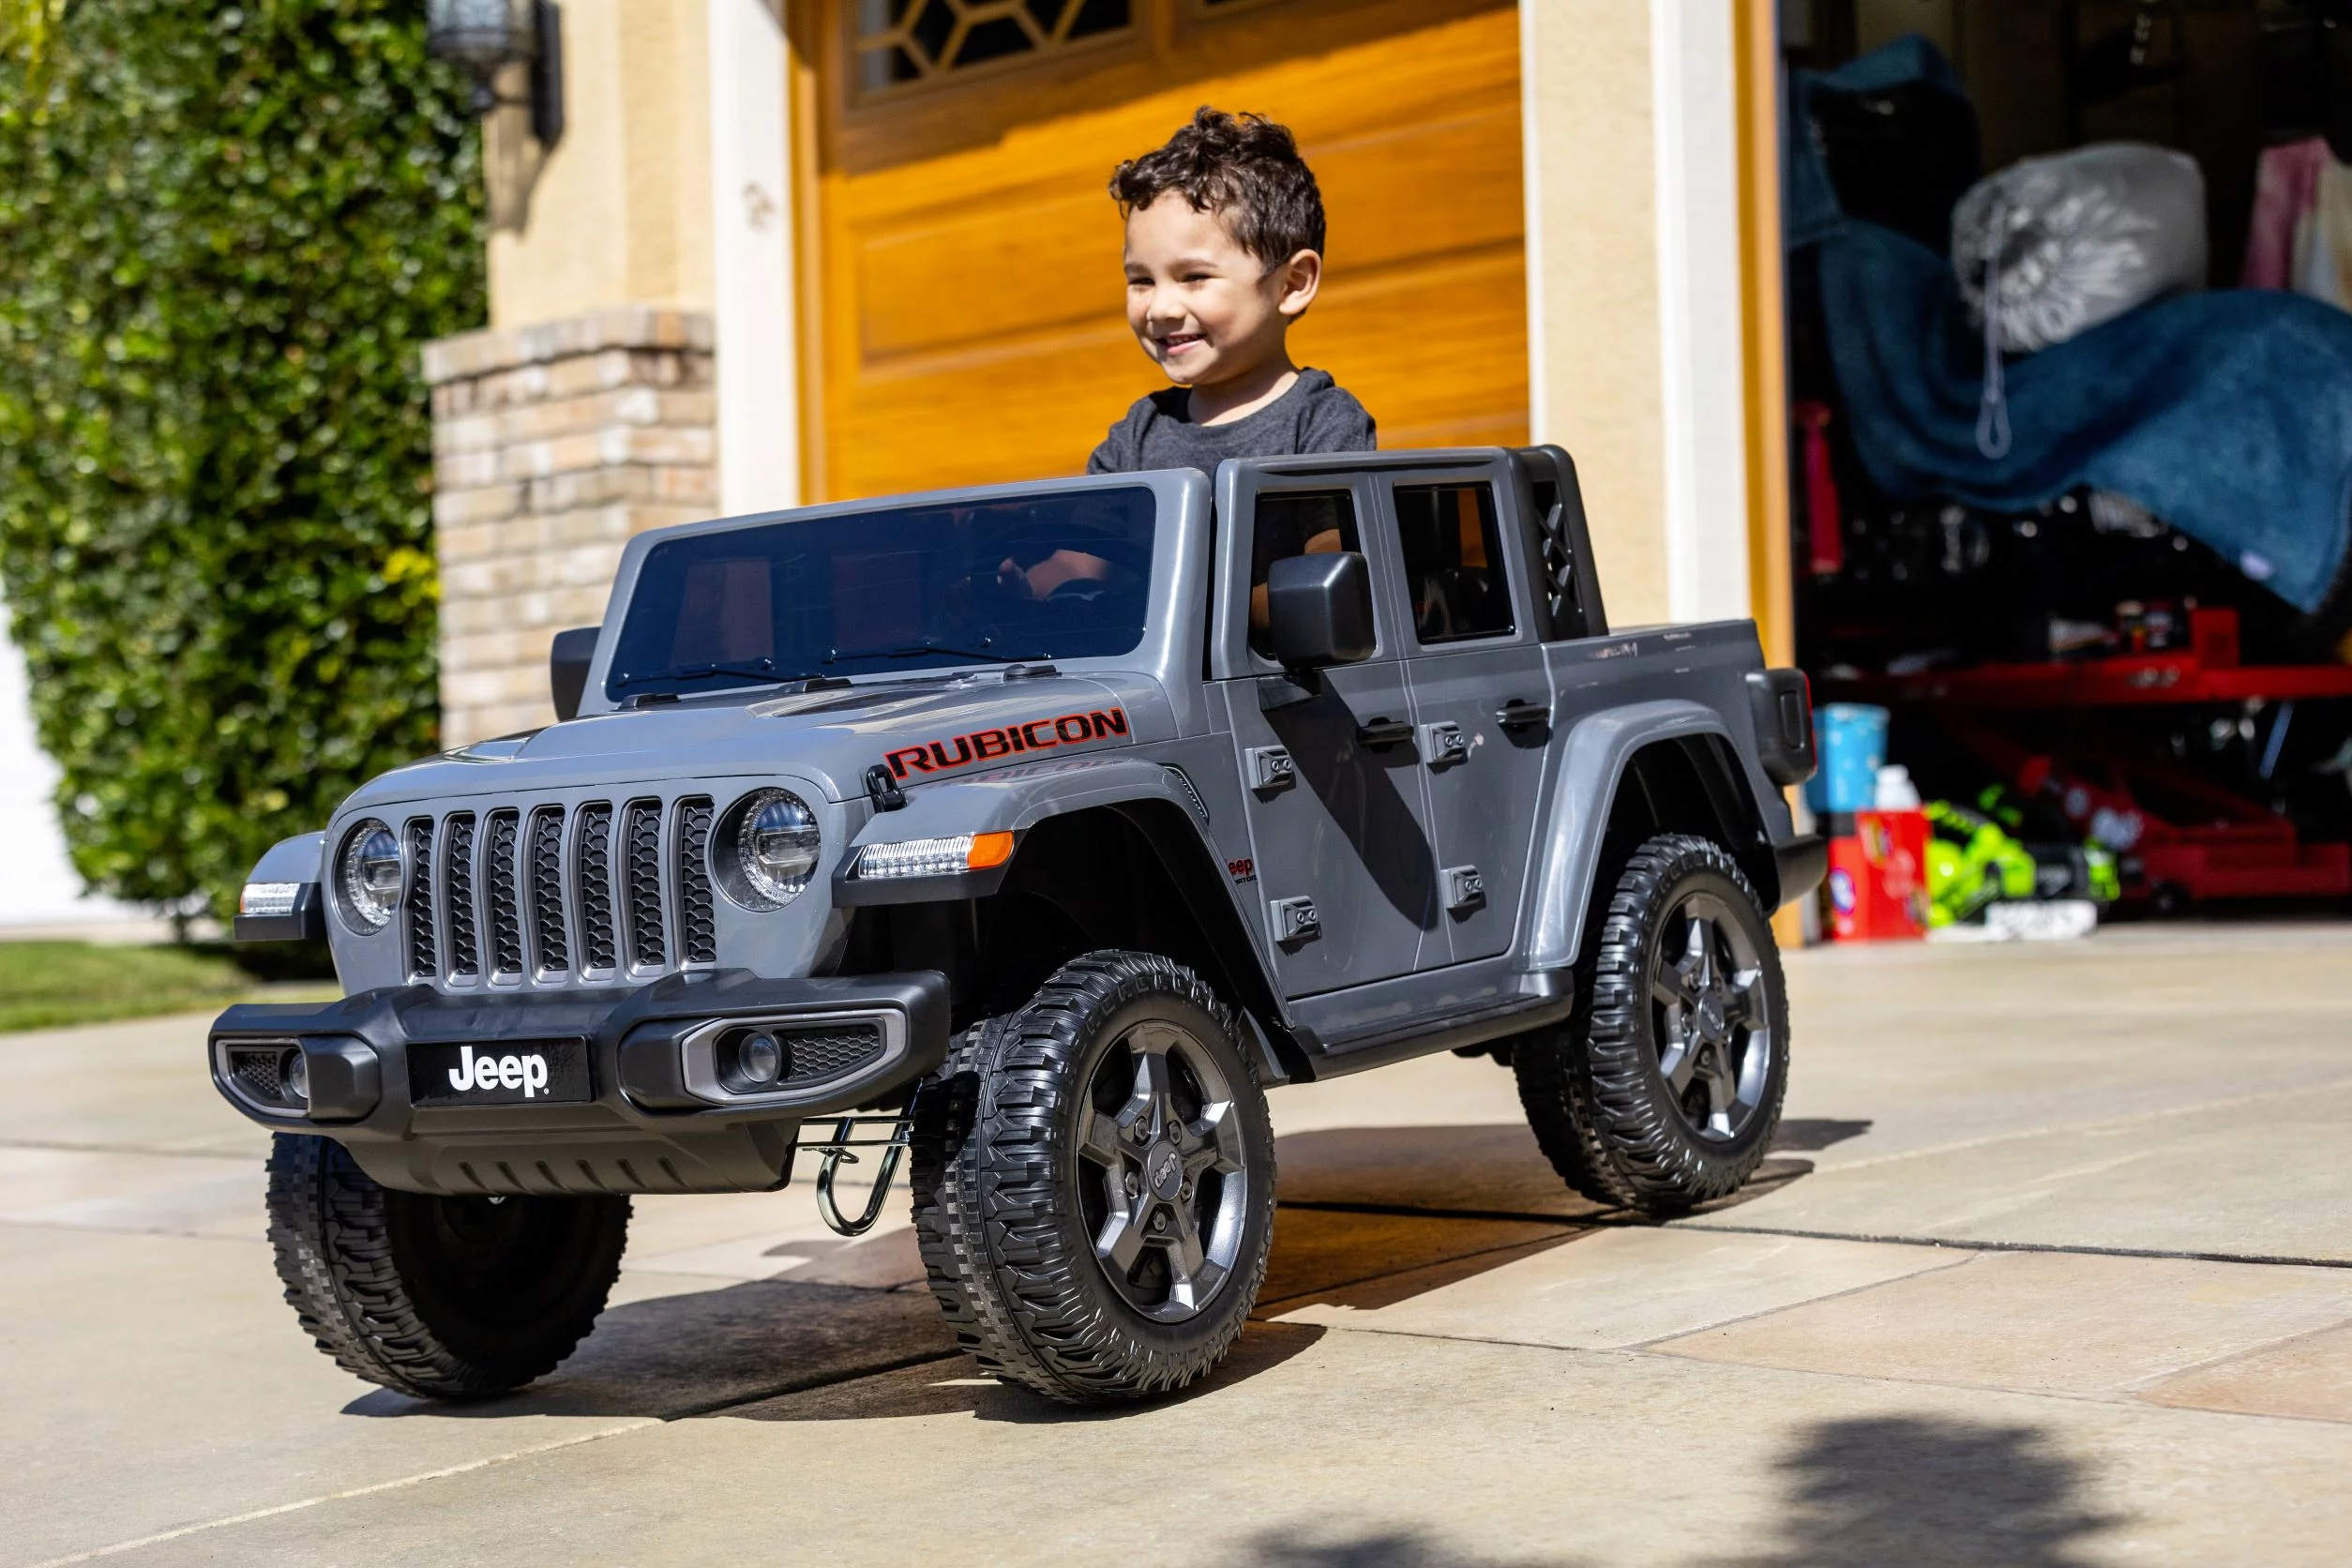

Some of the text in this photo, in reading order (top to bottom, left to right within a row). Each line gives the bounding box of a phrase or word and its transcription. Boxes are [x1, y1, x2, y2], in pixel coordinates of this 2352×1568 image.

[884, 707, 1129, 780] RUBICON
[1227, 858, 1253, 876] eep
[448, 1046, 548, 1097] Jeep
[1154, 1153, 1176, 1188] Jeep
